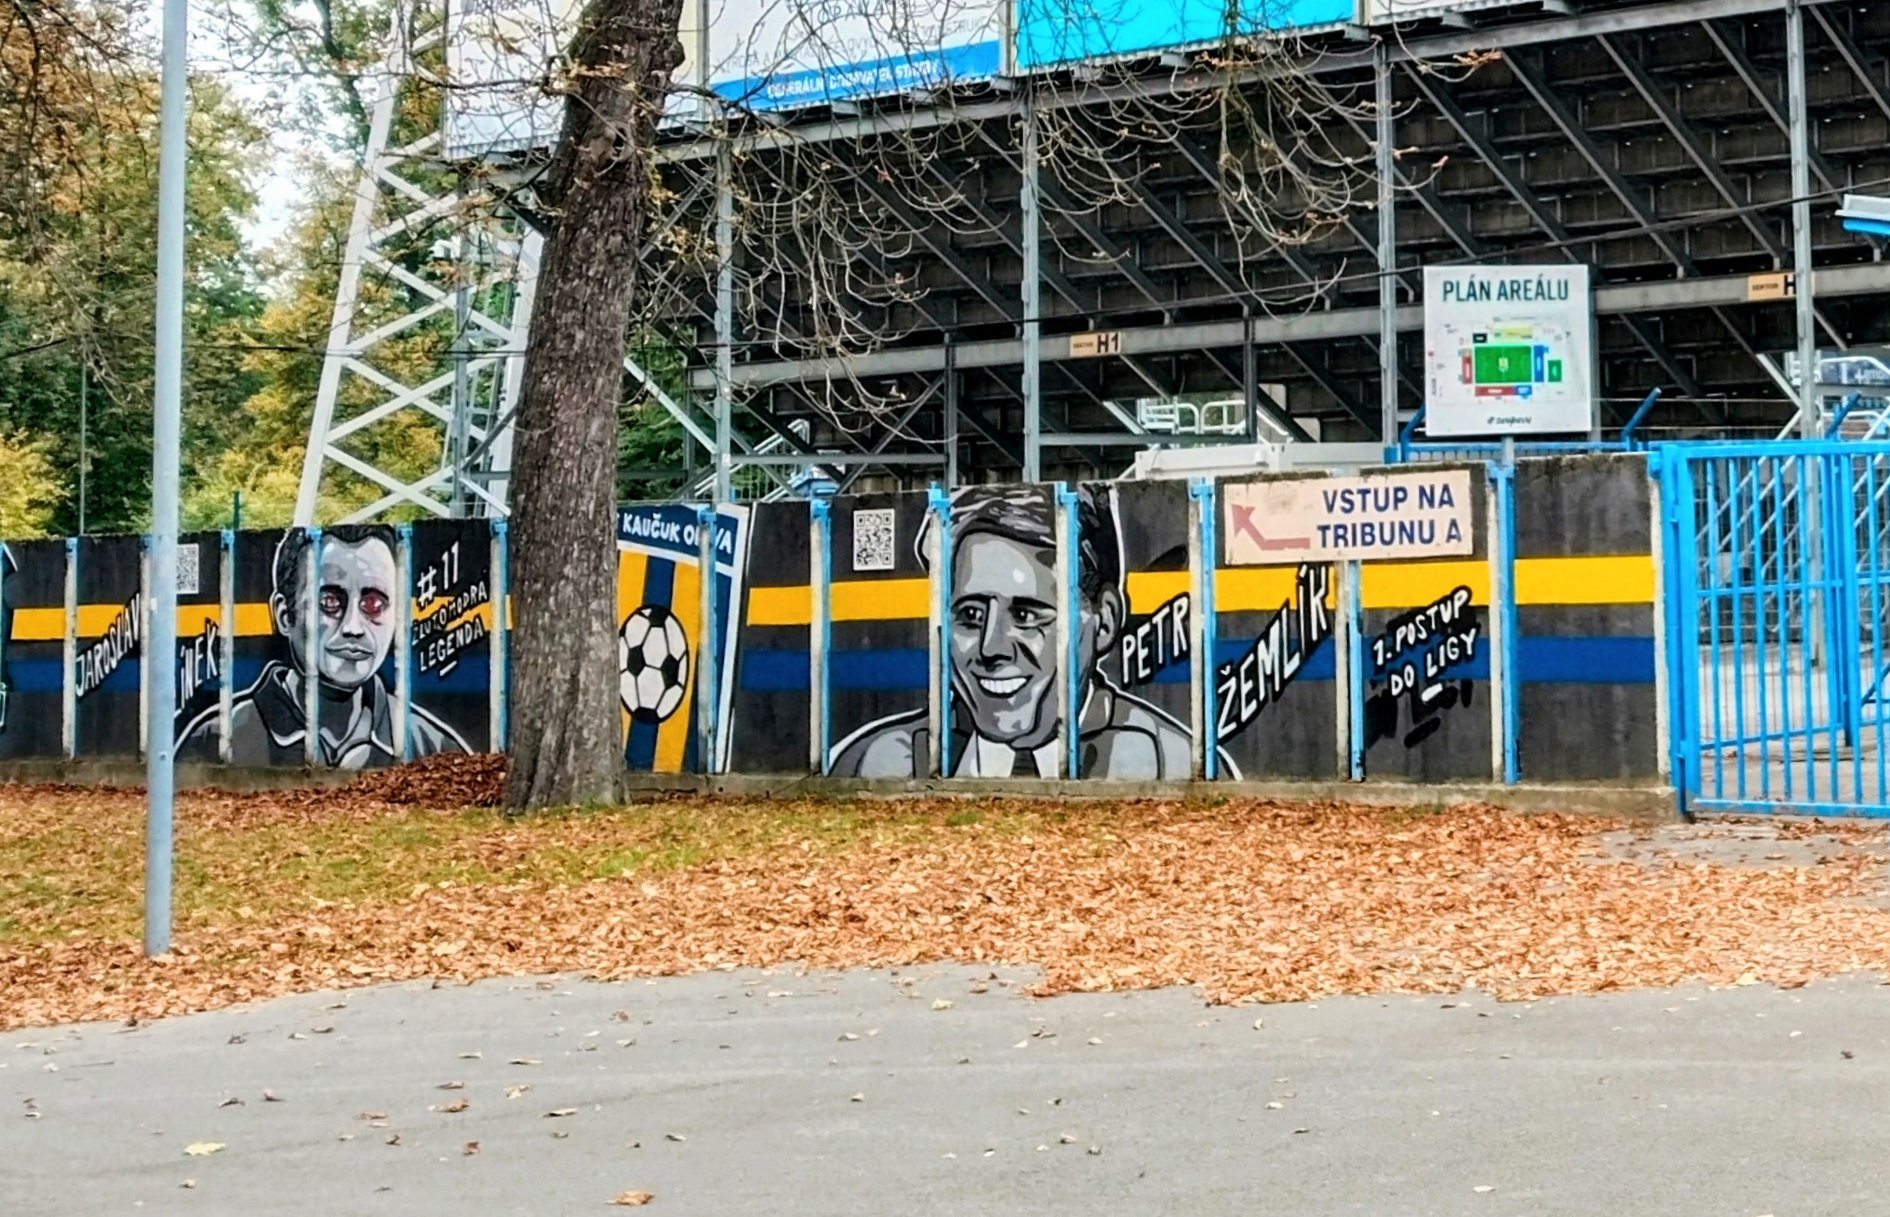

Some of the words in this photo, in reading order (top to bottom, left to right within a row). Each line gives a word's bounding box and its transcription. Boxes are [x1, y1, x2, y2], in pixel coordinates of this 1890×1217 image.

[1442, 273, 1491, 303] PLÁN
[1496, 273, 1569, 302] AREÁLU
[1783, 273, 1797, 296] H
[1096, 331, 1119, 354] H1
[1322, 485, 1408, 515] VSTUP
[1418, 483, 1455, 510] NA
[622, 512, 681, 543] KAUČUK
[1316, 518, 1436, 549] TRIBUNU
[1445, 518, 1462, 544] A
[416, 540, 459, 607] #11
[1394, 587, 1470, 651] POSTUP
[75, 592, 141, 698] JAROSLAV
[174, 623, 219, 719] ÍNEK
[420, 617, 484, 672] LEGENDA
[1121, 594, 1190, 684] PETR
[1217, 564, 1328, 739] ŽEMLÍK
[1389, 668, 1414, 697] DO
[1425, 627, 1477, 678] LIGY
